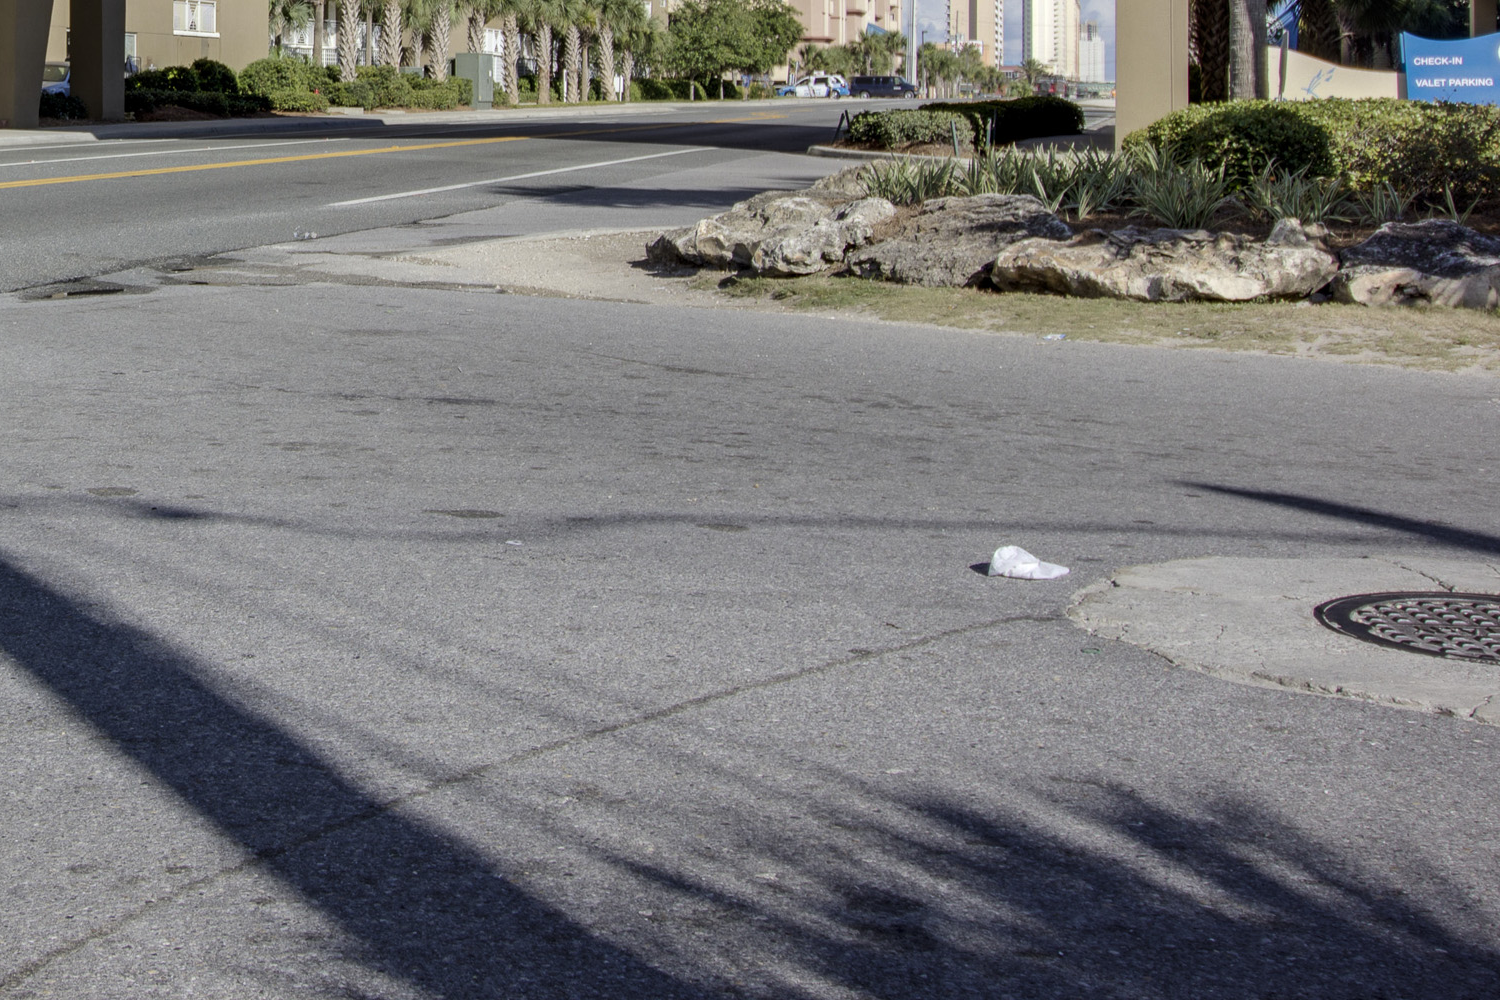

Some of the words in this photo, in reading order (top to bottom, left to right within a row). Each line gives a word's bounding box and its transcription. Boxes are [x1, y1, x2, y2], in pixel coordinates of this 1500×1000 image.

[1413, 56, 1463, 66] CHECK-IN
[1415, 79, 1446, 88] VALET
[1448, 77, 1494, 87] PARKING
